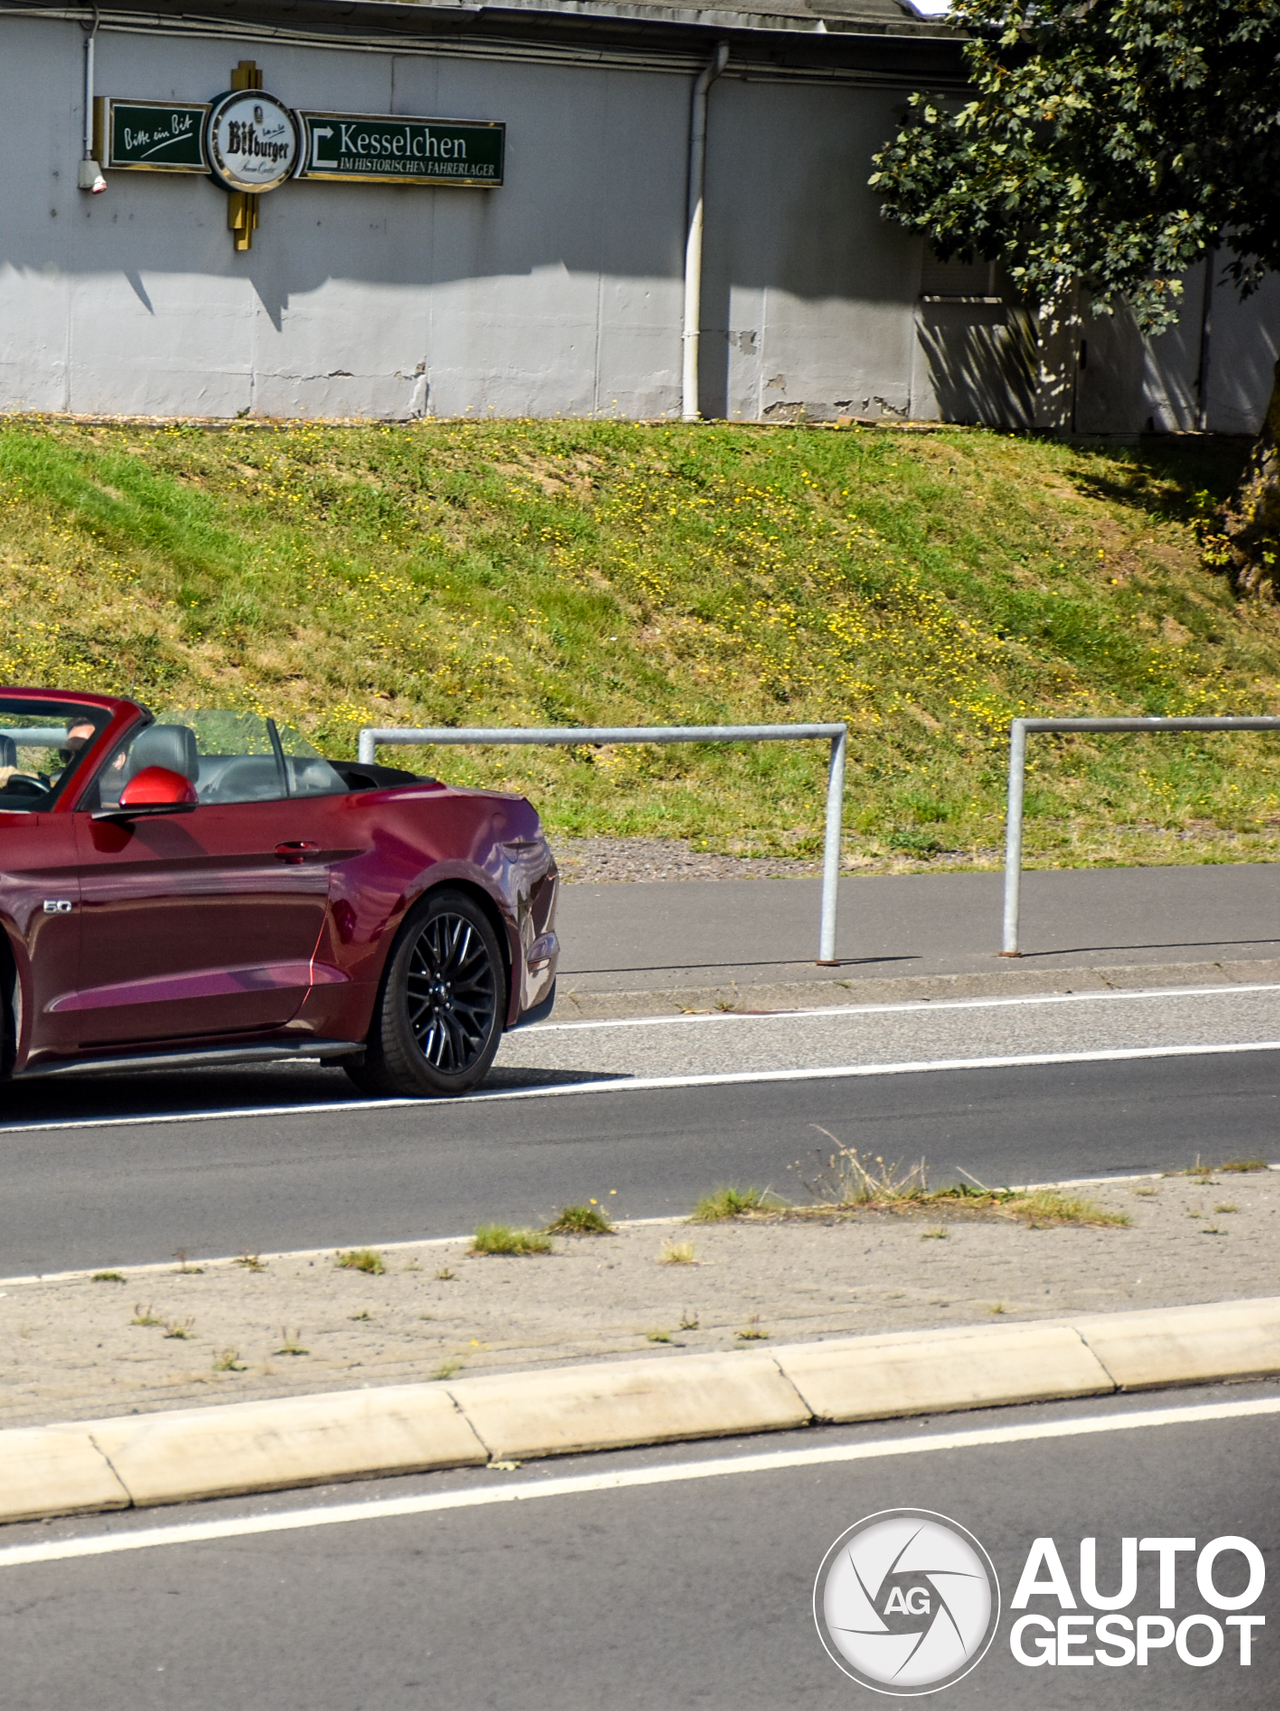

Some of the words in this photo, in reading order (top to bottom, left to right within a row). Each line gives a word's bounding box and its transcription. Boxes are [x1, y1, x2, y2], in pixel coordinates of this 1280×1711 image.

[124, 127, 151, 150] Bitte
[153, 127, 170, 140] ein
[171, 114, 193, 134] Bit
[227, 120, 289, 163] Bitburger
[339, 124, 468, 159] Kesselchen
[339, 157, 354, 170] IM
[355, 158, 428, 173] HISTORISCHEN
[427, 162, 495, 177] FAHRERLAGER
